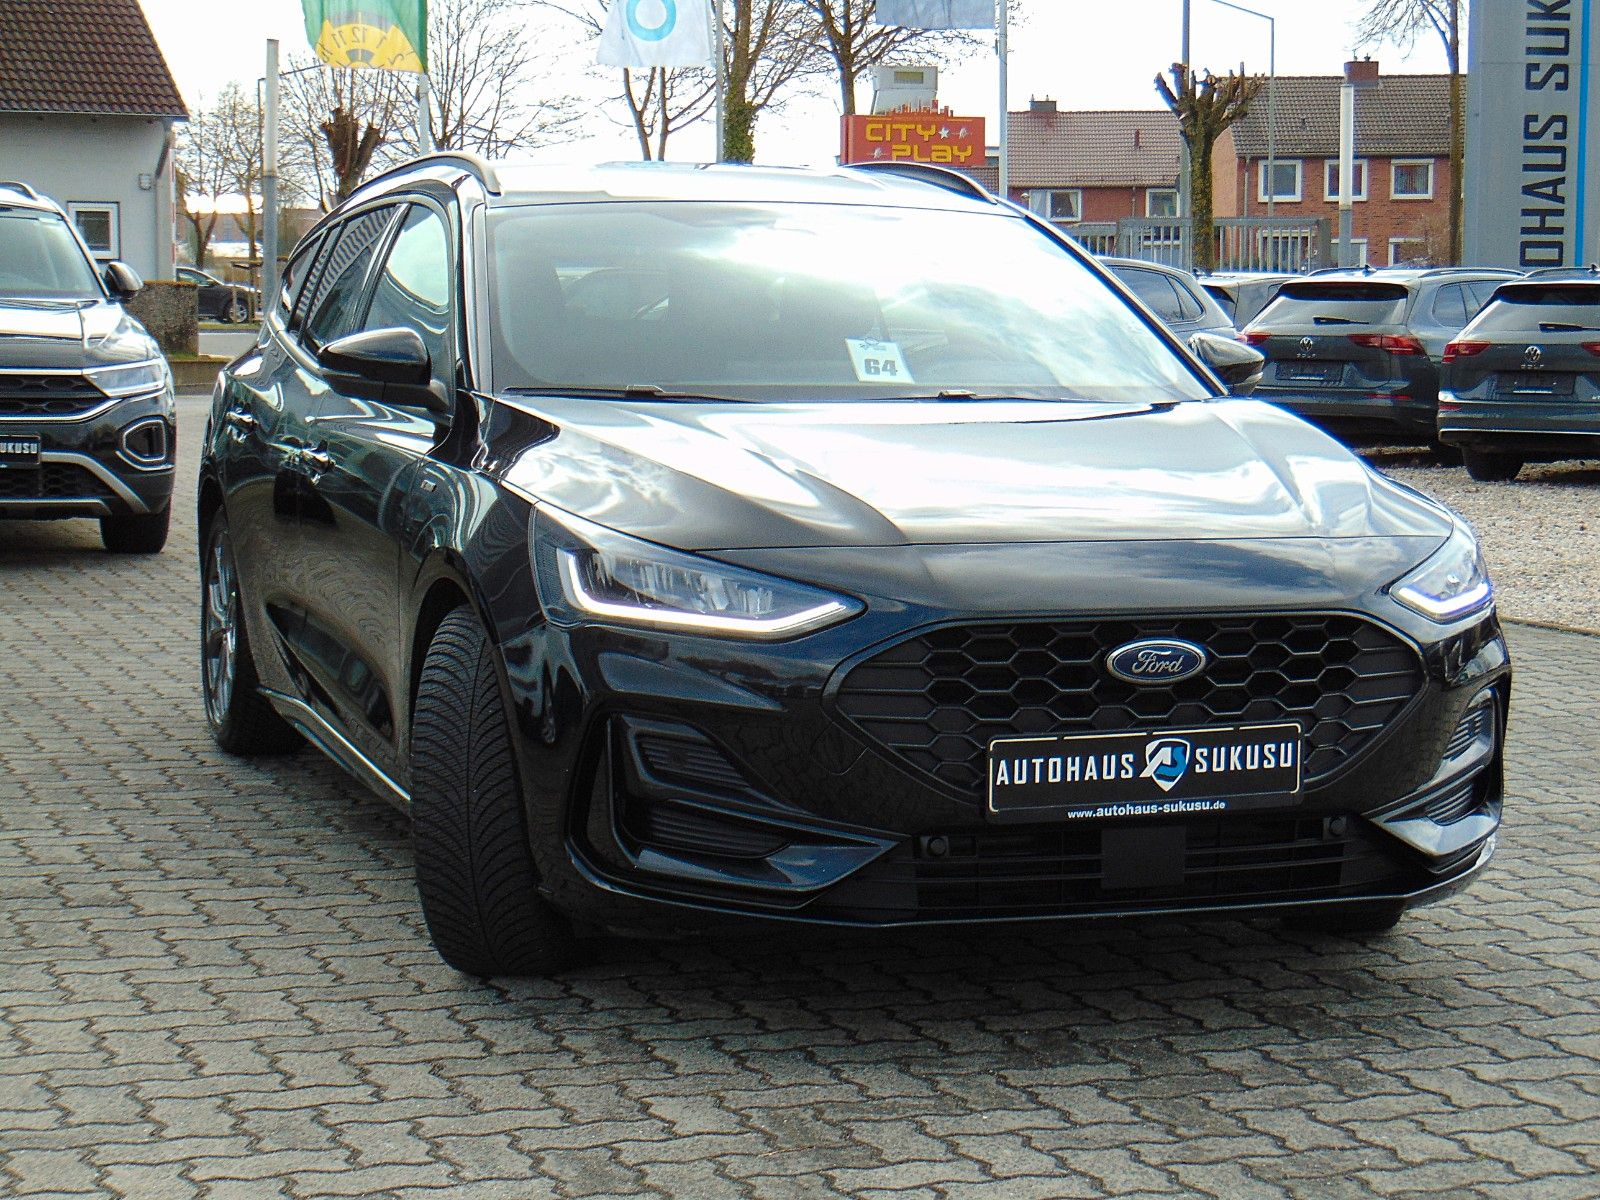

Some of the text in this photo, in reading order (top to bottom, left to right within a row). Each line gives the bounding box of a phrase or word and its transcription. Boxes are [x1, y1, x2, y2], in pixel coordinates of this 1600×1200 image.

[865, 123, 937, 141] CITY
[864, 358, 897, 376] 64
[1132, 648, 1183, 675] Ford
[996, 753, 1135, 786] AUTOHAUS
[1194, 742, 1294, 774] SUKUSU
[1067, 800, 1226, 819] www.autohaus-sukusu.de
